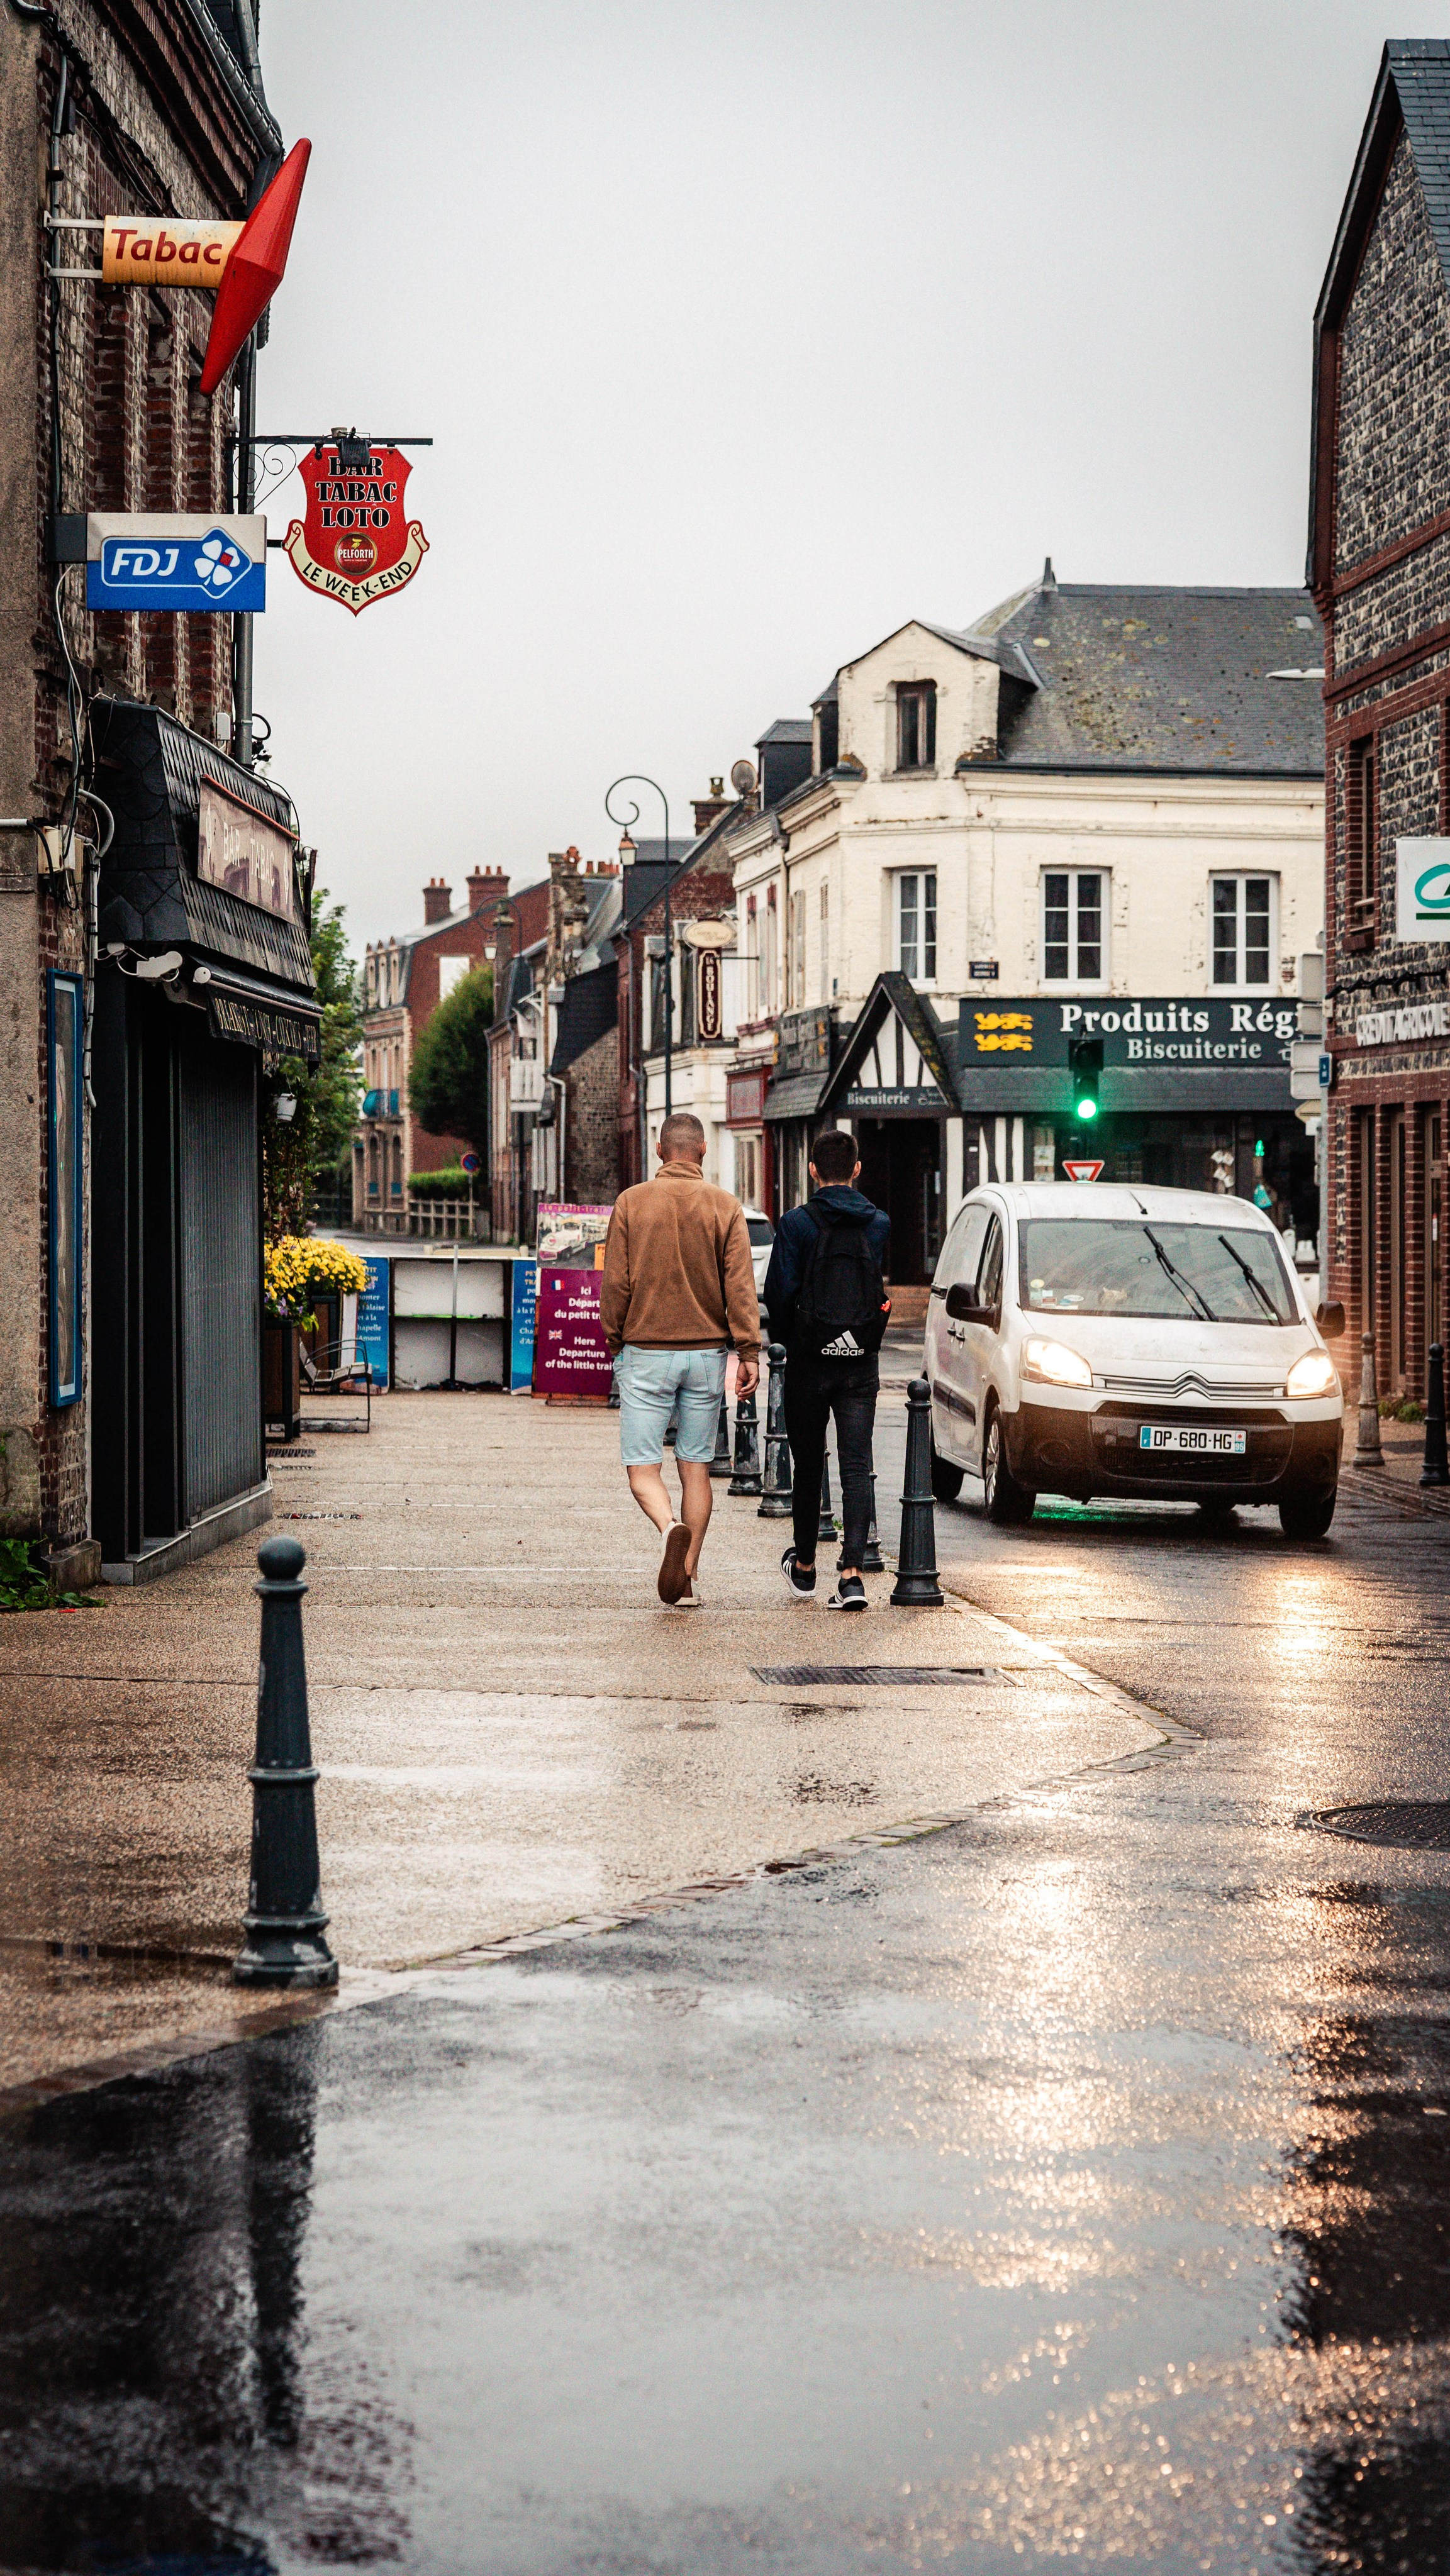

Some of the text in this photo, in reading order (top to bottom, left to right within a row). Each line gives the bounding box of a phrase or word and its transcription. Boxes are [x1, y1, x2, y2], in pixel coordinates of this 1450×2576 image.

[111, 229, 223, 265] Tabac
[328, 456, 383, 476] BAR
[316, 482, 397, 502] TABAC
[321, 508, 390, 528] LOTO
[111, 548, 180, 577] FDJ
[338, 549, 374, 558] PELFORTH
[303, 561, 412, 601] LE WEEK-END
[223, 821, 275, 887] BAR TABAC
[1060, 1002, 1210, 1032] Produits
[1127, 1038, 1262, 1059] Biscuiterie
[847, 1091, 910, 1105] Biscuiterie
[581, 1286, 591, 1295] Ici
[569, 1298, 600, 1309] Départ
[554, 1309, 566, 1318] du
[568, 1311, 590, 1320] petit
[574, 1336, 596, 1345] Here
[559, 1348, 605, 1358] Departure
[821, 1347, 864, 1356] adidas
[545, 1360, 612, 1370] of the little trai
[1154, 1430, 1232, 1450] DP-680-HG
